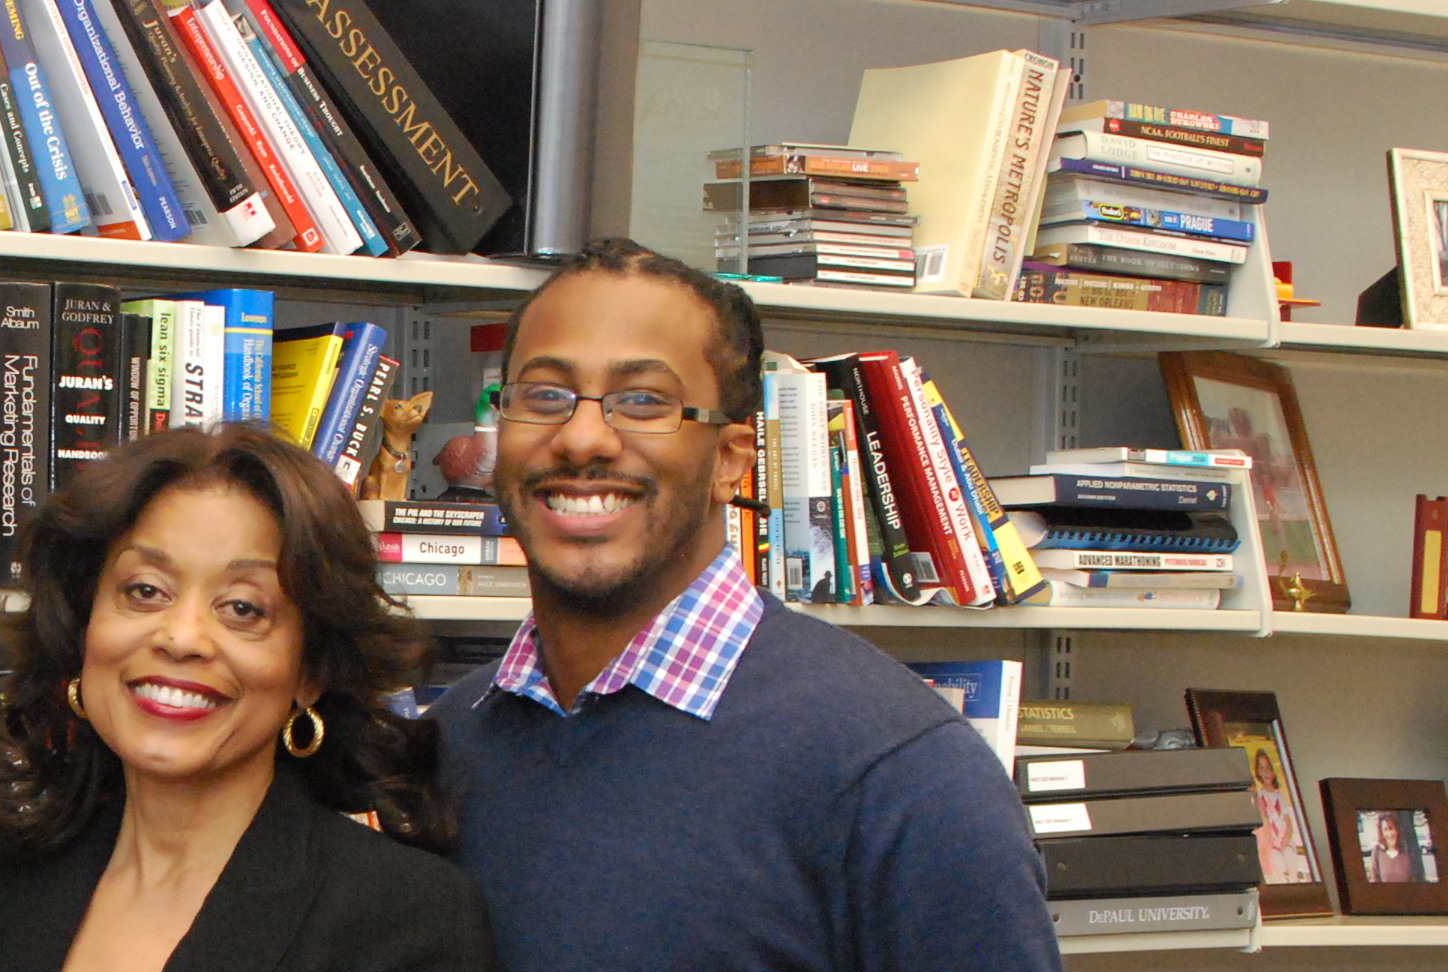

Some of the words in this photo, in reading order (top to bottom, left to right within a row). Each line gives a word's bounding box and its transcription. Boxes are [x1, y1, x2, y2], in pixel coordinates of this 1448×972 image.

[141, 15, 178, 67] Juran's
[182, 16, 227, 83] Entrepreneurship
[23, 61, 42, 90] Out
[258, 7, 295, 59] FOUNDATIONS
[288, 54, 301, 69] OF
[295, 66, 323, 103] BUSINESS
[316, 99, 345, 138] THOUGHT
[32, 90, 49, 109] of
[306, 0, 481, 205] ASSESSMENT
[1013, 68, 1044, 150] NATURE'S
[6, 111, 19, 129] and
[37, 109, 56, 134] the
[110, 90, 148, 151] Behavior
[1164, 129, 1205, 144] FOOTBALL'S
[1206, 135, 1230, 147] FINEST
[10, 131, 31, 174] Concepts
[45, 135, 70, 181] Crisis
[852, 163, 868, 172] LIVE
[156, 196, 178, 229] PEARSON
[991, 153, 1027, 264] METROPOLIS
[1180, 215, 1214, 232] PRAGUE
[6, 305, 34, 318] Smith
[61, 312, 114, 325] GODFREY
[65, 300, 101, 311] JURAN
[102, 301, 111, 312] &
[1, 317, 39, 329] Albaum
[158, 312, 171, 339] lean
[158, 344, 169, 362] six
[59, 376, 113, 390] JURAN'S
[131, 357, 140, 389] WINDOW
[366, 361, 391, 402] PEARL
[0, 354, 19, 445] Marketing
[154, 367, 169, 407] sigma
[851, 367, 869, 415] NORTHOUSE
[21, 355, 38, 486] Fundamentals
[65, 414, 105, 425] QUALITY
[360, 404, 374, 419] S.
[909, 369, 943, 446] Personality
[345, 422, 367, 457] BUCK
[756, 411, 766, 446] HAILE
[950, 437, 966, 464] Dubai
[898, 395, 930, 467] PERFORMANCE
[922, 466, 952, 536] MANAGEMENT
[934, 448, 955, 483] Style
[959, 463, 968, 471] &
[0, 448, 18, 537] Research
[863, 430, 902, 531] LEADERSHIP
[947, 487, 961, 500] AT
[962, 472, 974, 488] Abu
[1077, 480, 1103, 488] APPLIED
[1105, 481, 1160, 491] NONPARAMETRIC
[1161, 483, 1197, 493] STATISTICS
[21, 488, 35, 508] of
[968, 487, 984, 515] Dhabi
[395, 508, 406, 516] THE
[408, 509, 418, 517] PIG
[419, 509, 432, 517] AND
[433, 510, 445, 518] THE
[445, 510, 484, 520] SKYSCRAPER
[952, 503, 974, 541] Work
[420, 542, 465, 557] Chicago
[1079, 555, 1113, 566] ADVANCED
[1115, 556, 1161, 567] MARATHONING
[383, 572, 447, 586] CHICAGO
[1018, 707, 1075, 720] STATISTICS
